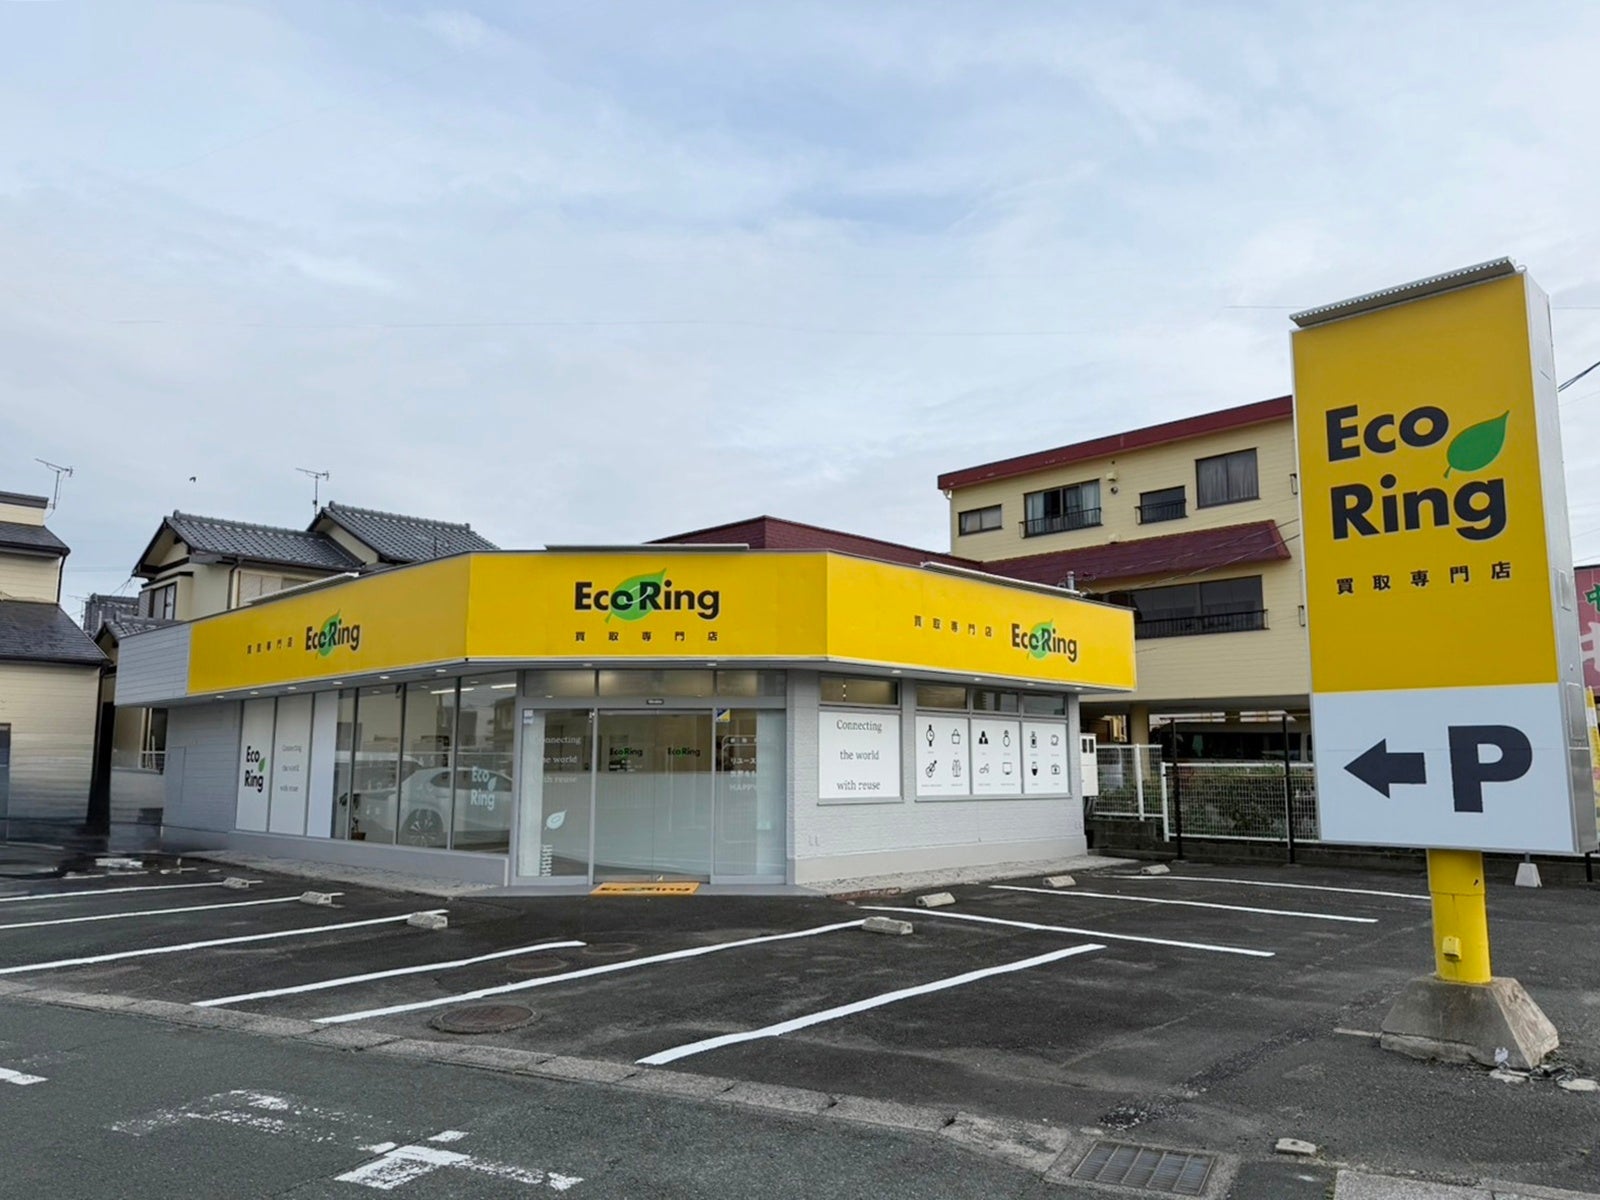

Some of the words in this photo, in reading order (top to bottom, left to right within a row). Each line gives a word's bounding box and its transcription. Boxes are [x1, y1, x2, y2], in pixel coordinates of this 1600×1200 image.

[1325, 404, 1449, 462] Eco
[1330, 474, 1507, 541] Ring
[1336, 561, 1512, 596] 買取専門店
[575, 631, 719, 642] 買取専門店
[836, 719, 883, 734] Connecting
[246, 745, 260, 763] Eco
[839, 749, 854, 761] the
[855, 749, 880, 761] world
[471, 766, 490, 783] Eco
[1447, 724, 1533, 813] P
[244, 769, 264, 793] Ring
[836, 779, 857, 791] with
[858, 780, 881, 791] reuse
[470, 789, 495, 811] Ring
